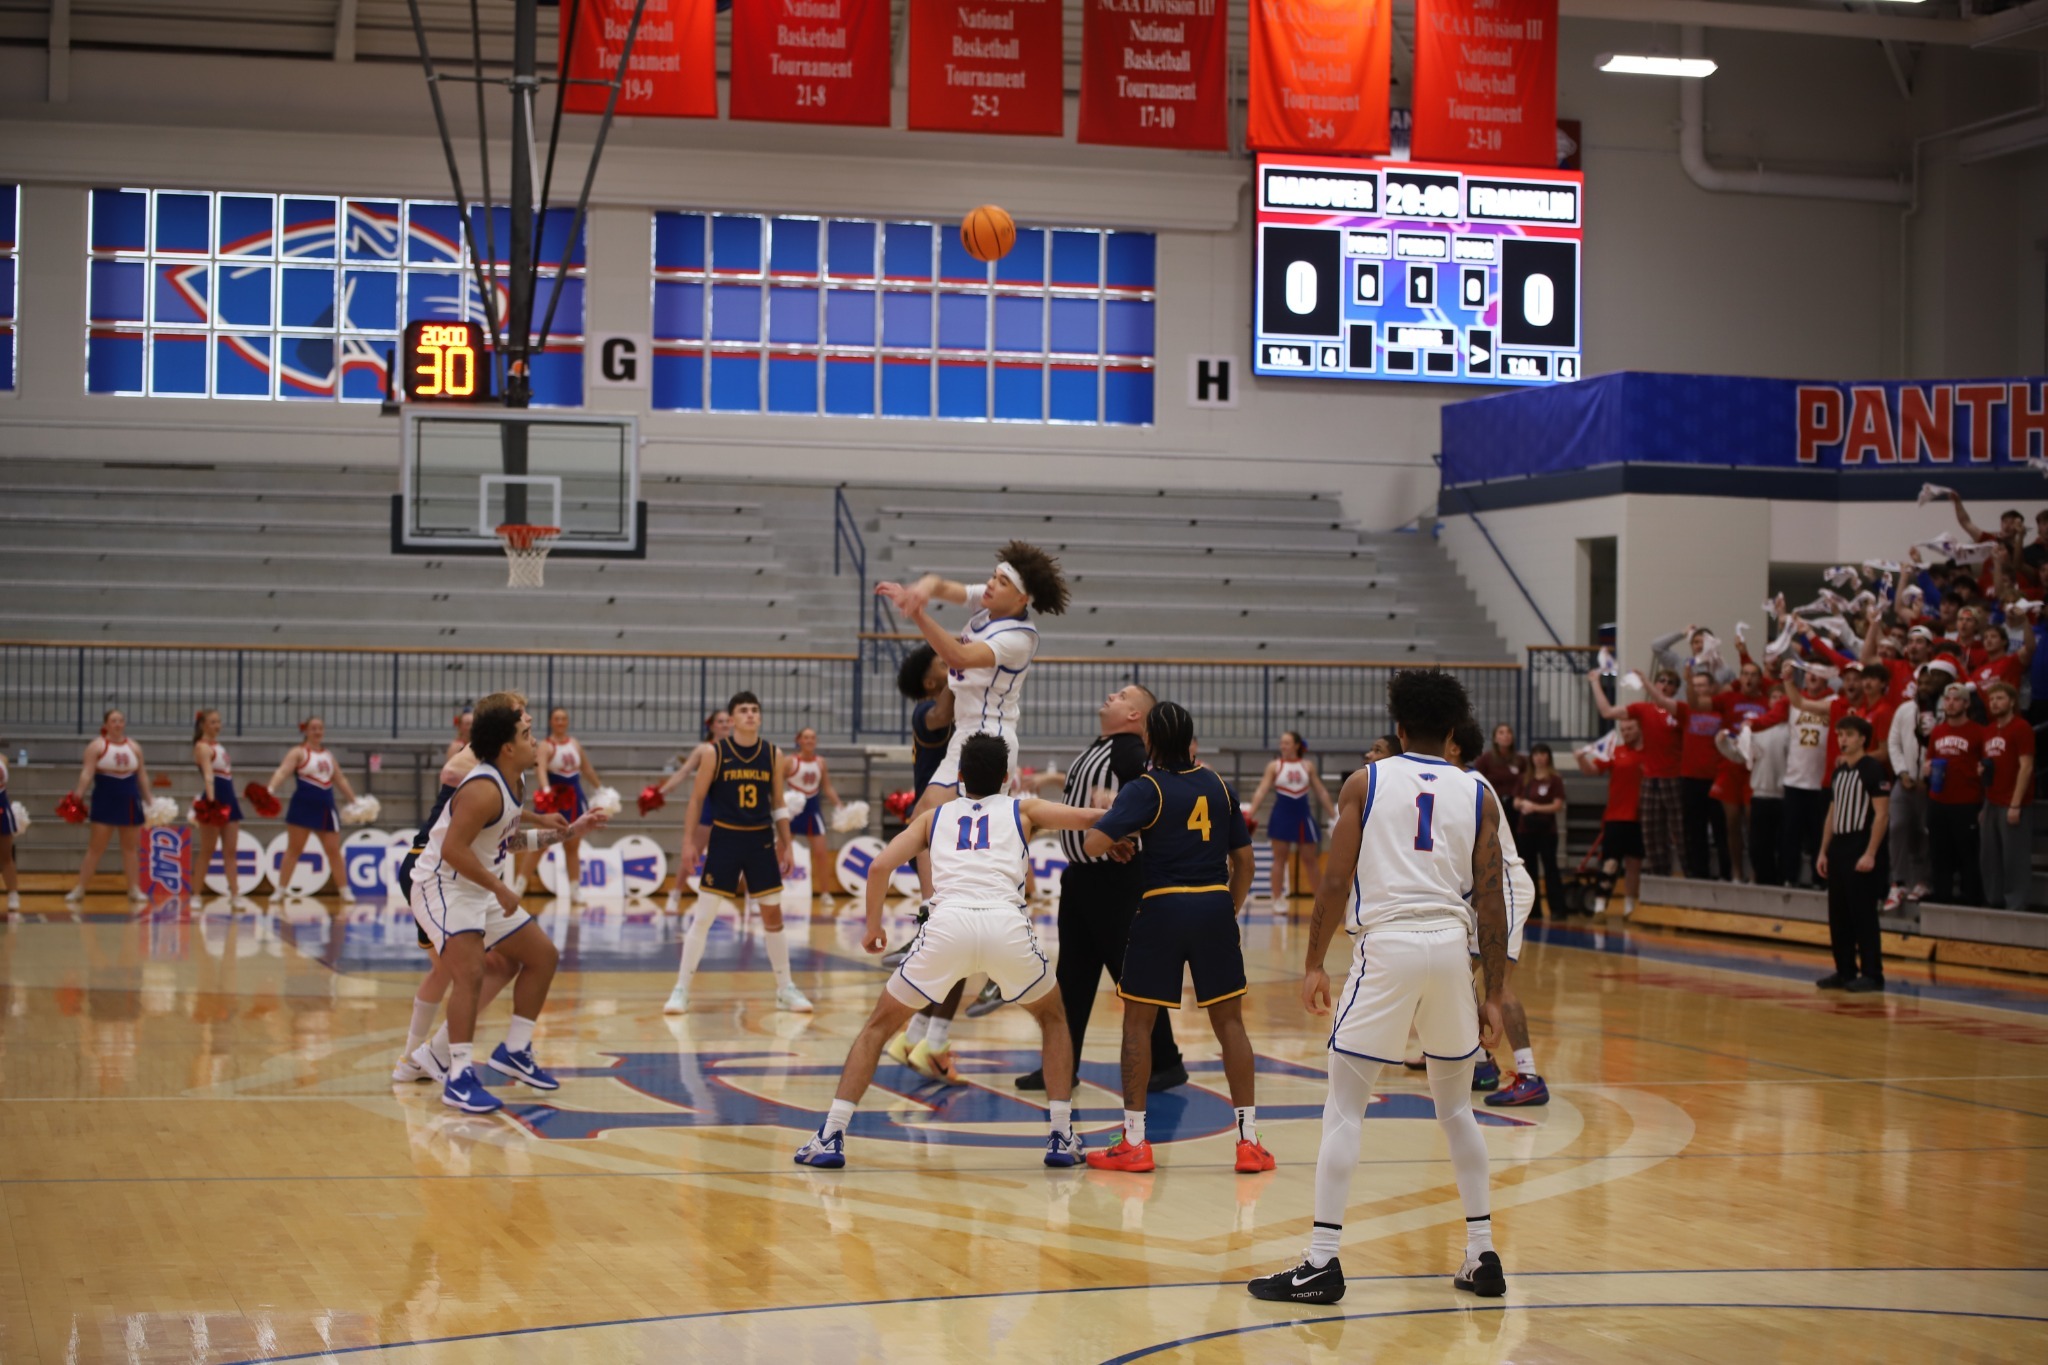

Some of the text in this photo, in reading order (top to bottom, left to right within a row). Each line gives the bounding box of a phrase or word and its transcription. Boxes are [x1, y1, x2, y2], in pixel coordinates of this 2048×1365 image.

[784, 0, 841, 19] National
[958, 7, 1014, 30] National
[777, 24, 846, 48] Basketball
[1130, 19, 1185, 43] National
[1429, 12, 1471, 36] NCAA
[1474, 16, 1523, 39] Division
[952, 35, 1019, 59] Basketball
[1123, 47, 1191, 72] Basketball
[1460, 43, 1513, 67] National
[770, 53, 852, 78] Tournament
[945, 63, 1025, 88] Tournament
[1288, 59, 1351, 87] Volleyball
[625, 79, 653, 101] 19-9
[796, 84, 826, 107] 21-8
[1117, 75, 1197, 100] Tournament
[1455, 70, 1516, 99] Volleyball
[1281, 87, 1360, 111] Tournament
[1447, 97, 1522, 123] Tournament
[1140, 105, 1175, 128] 17-10
[1467, 128, 1502, 150] 23-10
[1286, 260, 1318, 315] 0
[1414, 275, 1427, 298] 1
[1523, 273, 1554, 327] 0
[420, 325, 468, 346] 20:00
[415, 345, 475, 396] 30
[602, 338, 637, 382] G
[1197, 360, 1230, 401] H
[1800, 727, 1821, 747] 23
[723, 769, 771, 782] FRANKLIN
[738, 784, 758, 809] 13
[1187, 795, 1212, 842] 4
[1414, 791, 1435, 853] 1
[956, 814, 991, 851] 11
[150, 827, 183, 895] CLAP
